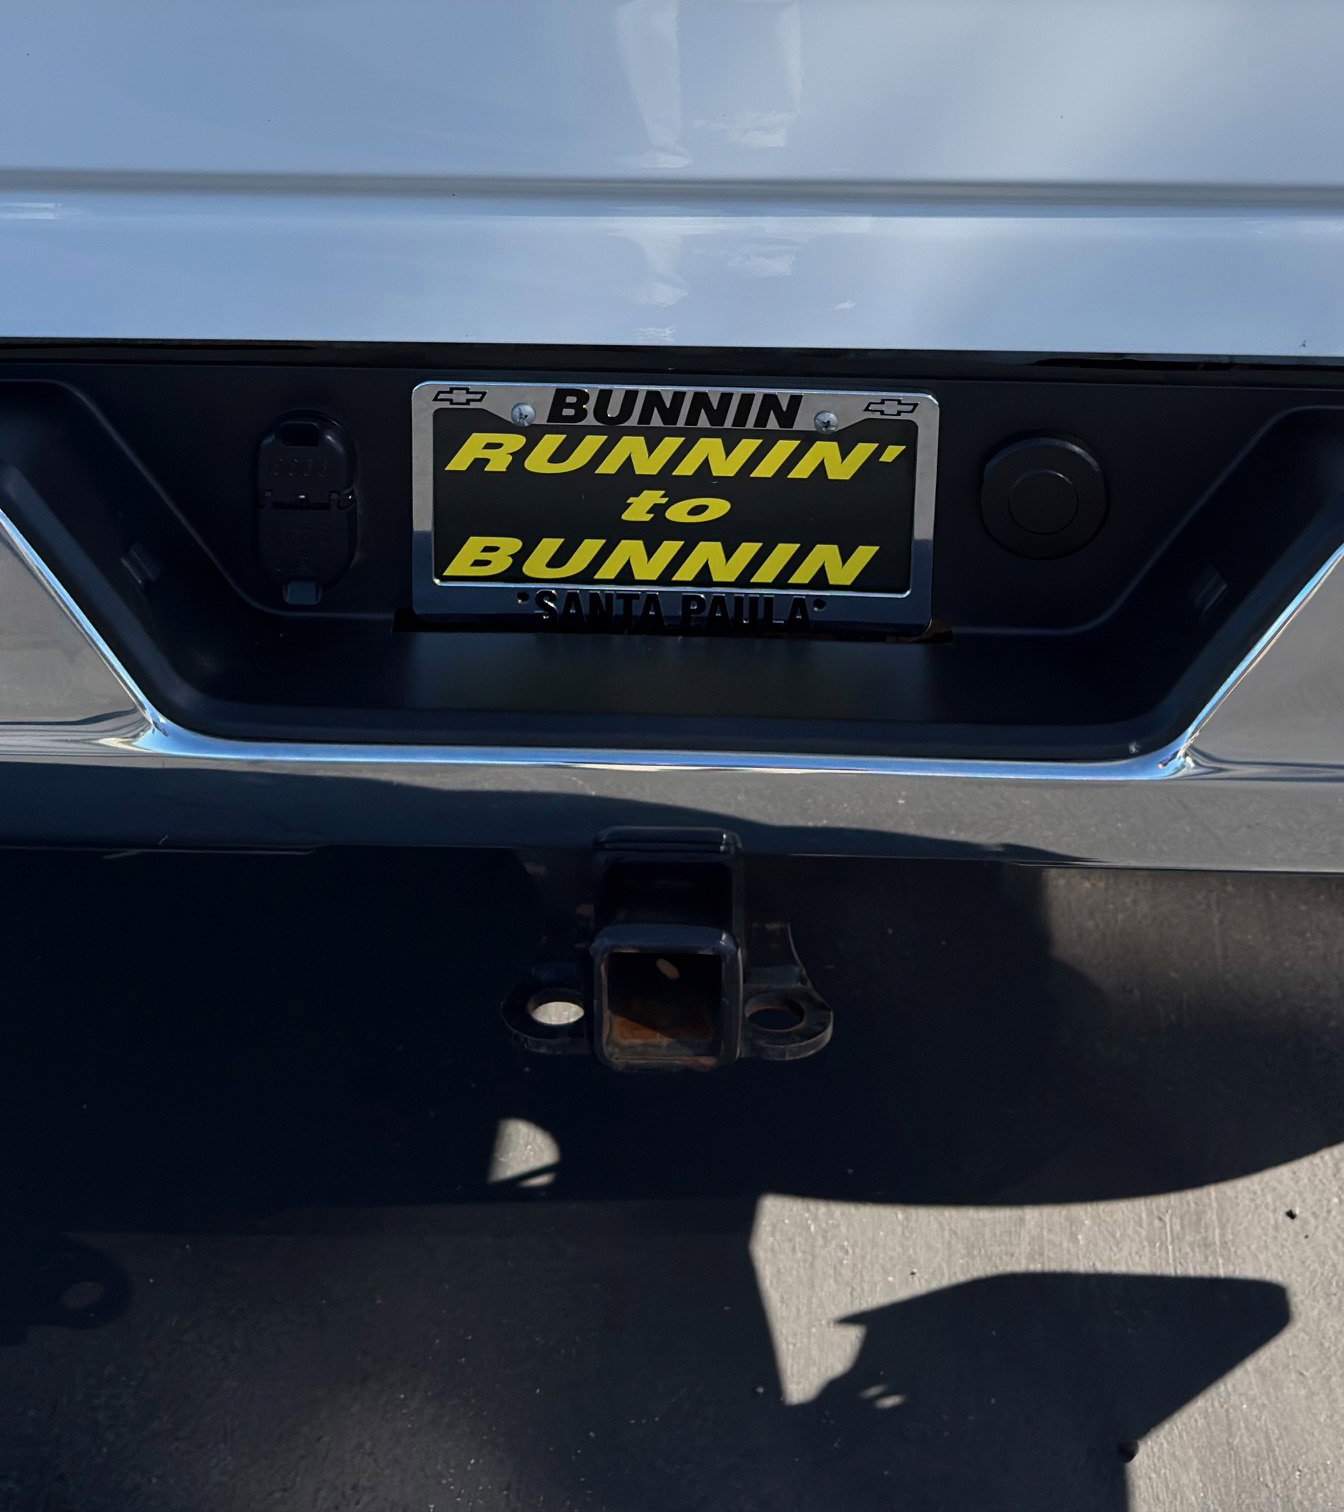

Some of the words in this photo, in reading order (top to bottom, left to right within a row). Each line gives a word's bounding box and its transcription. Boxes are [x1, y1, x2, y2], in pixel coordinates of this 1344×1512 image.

[546, 388, 804, 429] BUNNIN
[444, 432, 907, 481] RUNNIN'
[621, 490, 731, 524] to
[442, 536, 881, 587] BUNNIN
[534, 589, 667, 632] SANTA
[680, 593, 813, 634] PAULA
